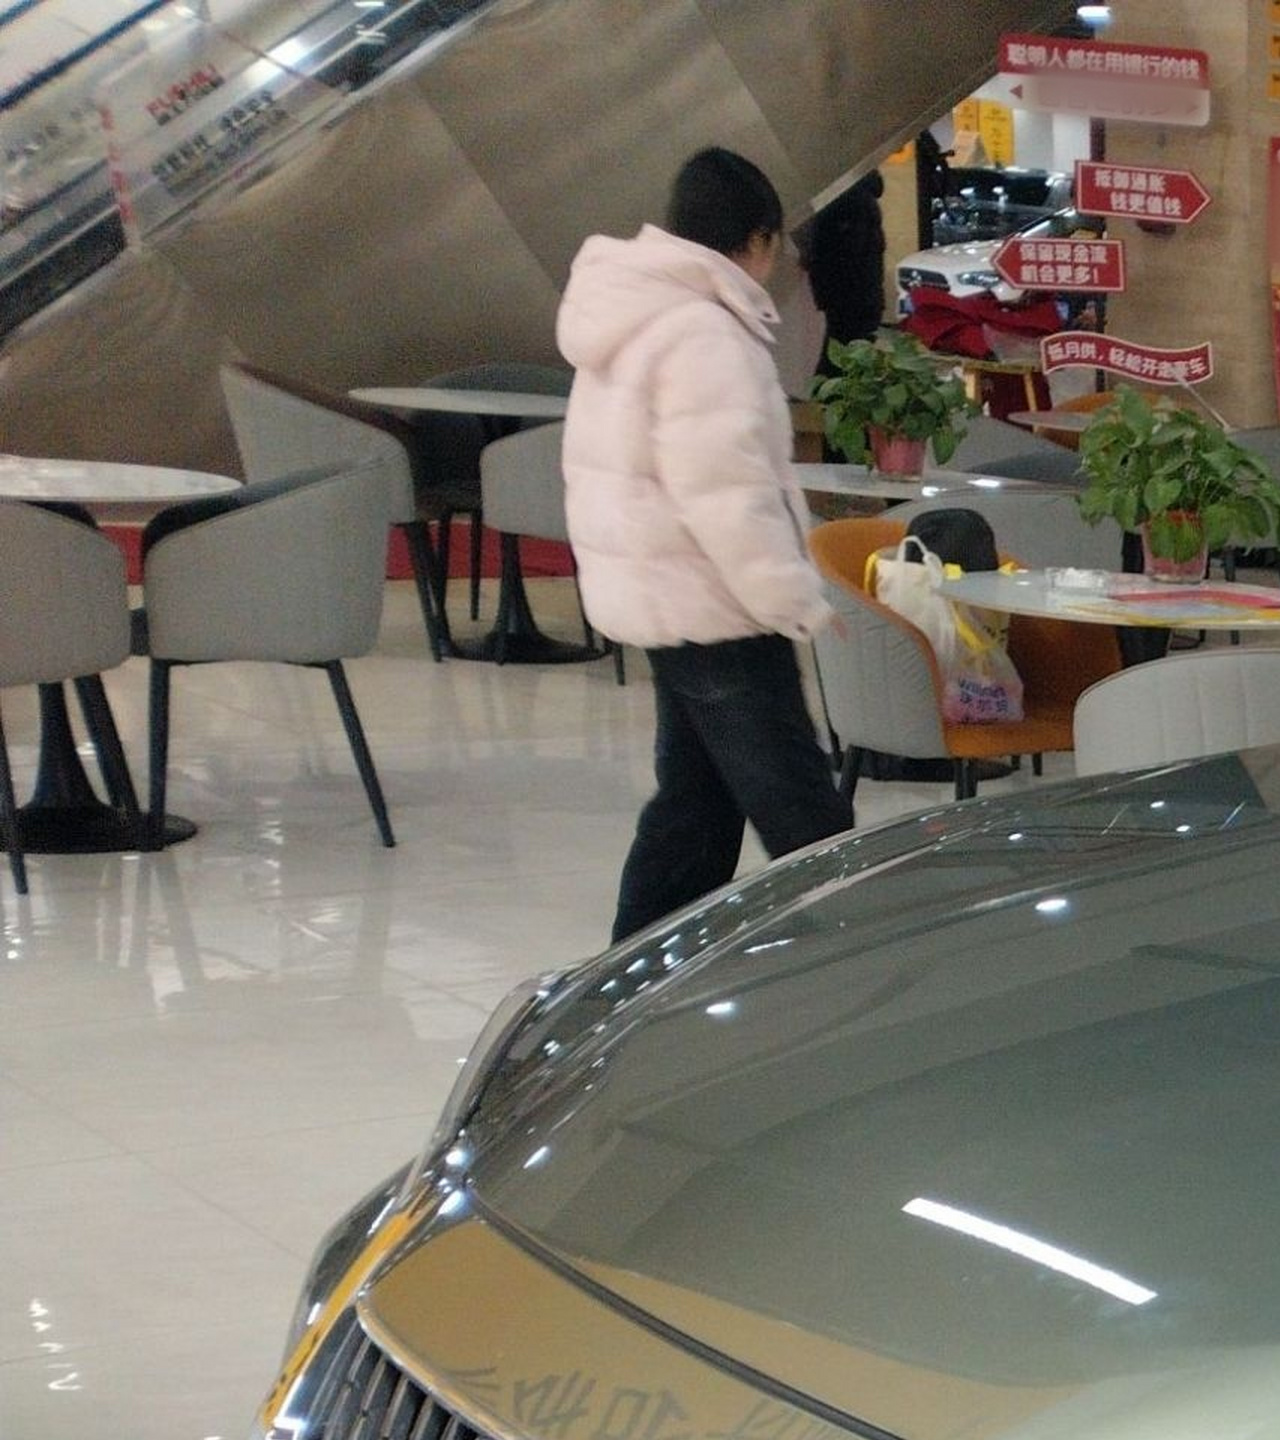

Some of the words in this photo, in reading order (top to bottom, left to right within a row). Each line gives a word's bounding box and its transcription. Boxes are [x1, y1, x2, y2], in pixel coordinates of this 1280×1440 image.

[1007, 43, 1199, 80] 聪明人都在用银行的钱
[1110, 191, 1182, 216] 钱更值钱
[1020, 243, 1107, 264] 保留现金流
